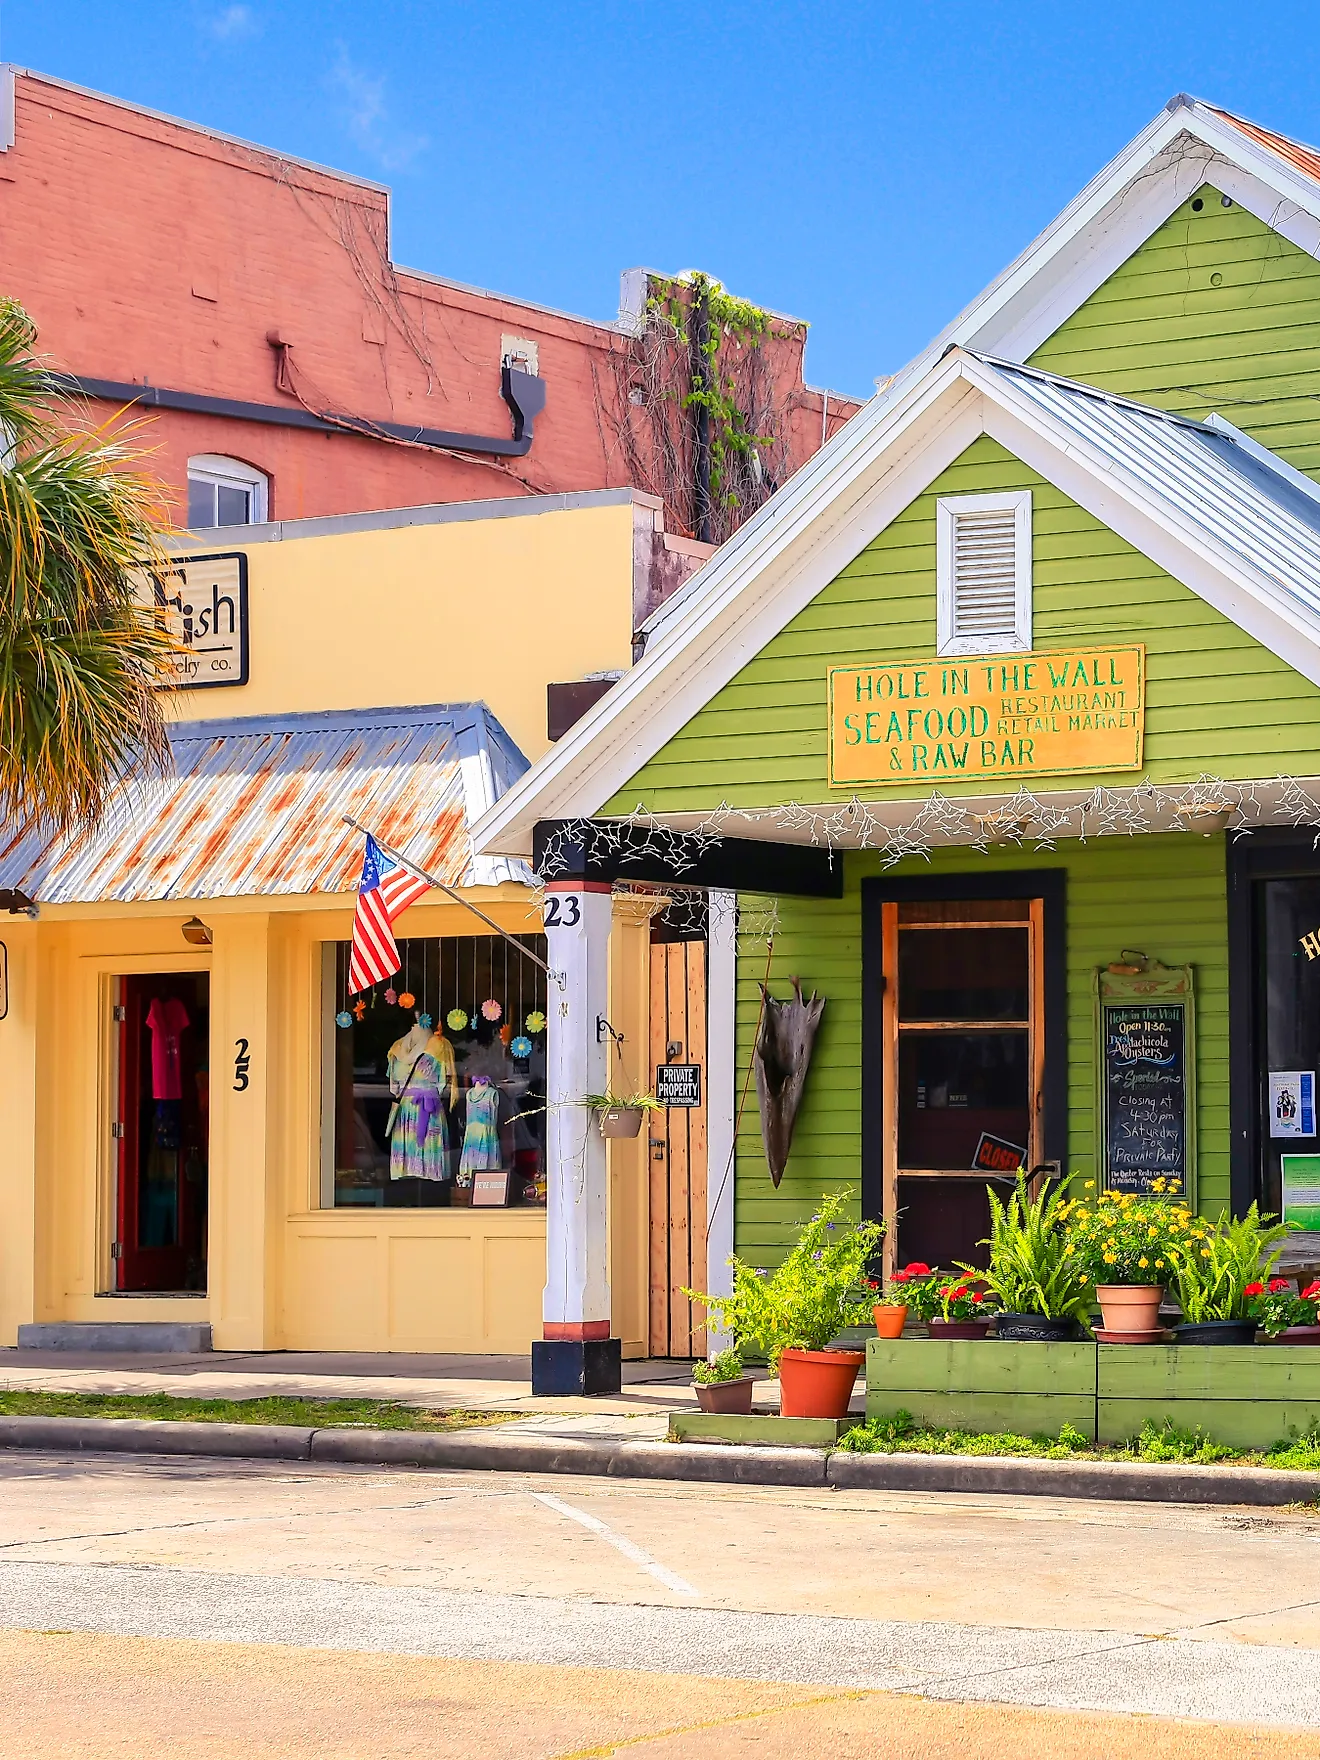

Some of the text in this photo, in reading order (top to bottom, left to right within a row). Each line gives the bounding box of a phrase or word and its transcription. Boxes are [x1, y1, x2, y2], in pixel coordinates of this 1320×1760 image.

[210, 658, 232, 671] co.
[855, 657, 1124, 702] HOLE IN THE WALL
[1000, 691, 1127, 715] RESTAURANT
[844, 705, 990, 746] SEAFOOD
[997, 710, 1140, 736] RETAIL MARKET
[889, 739, 1036, 772] & RAW BAR
[544, 896, 581, 927] 23
[1143, 1007, 1157, 1019] the
[1118, 1022, 1141, 1034] Open
[1125, 1043, 1163, 1062] Oysters
[232, 1038, 251, 1092] 25
[663, 1068, 694, 1083] PRIVATE
[658, 1082, 698, 1097] PROPERTY
[1158, 1113, 1175, 1124] pm
